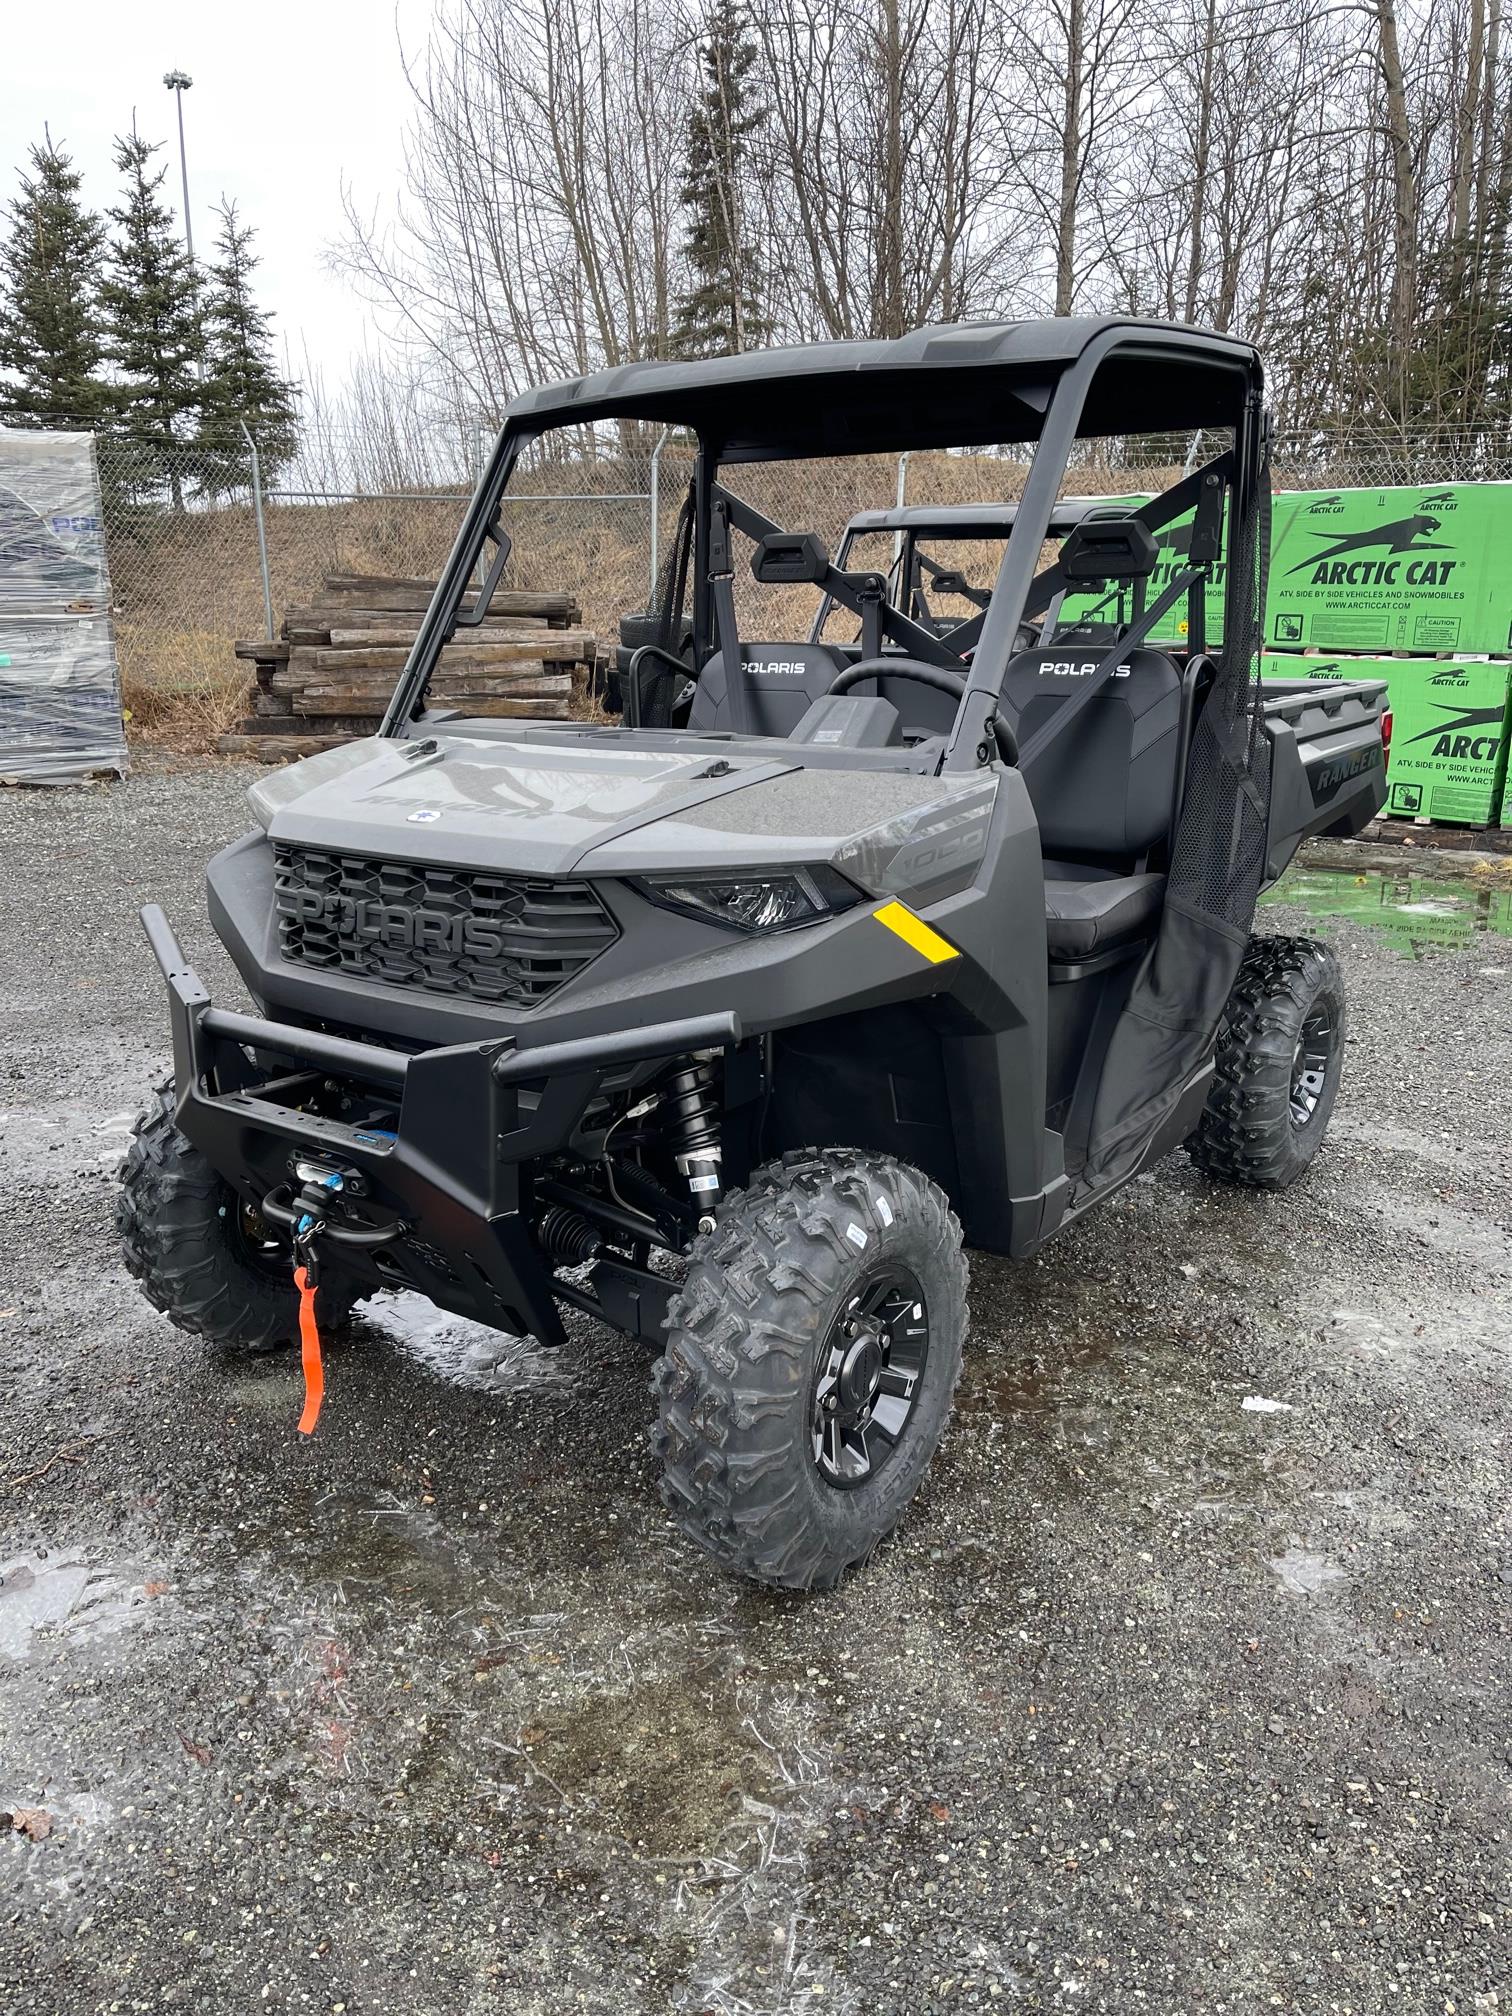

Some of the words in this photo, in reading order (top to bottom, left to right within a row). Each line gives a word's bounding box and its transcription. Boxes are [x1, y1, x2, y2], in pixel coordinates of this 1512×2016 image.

[1309, 506, 1332, 514] ARCTIC
[1420, 503, 1443, 511] ARCTIC
[1445, 503, 1459, 511] CAT
[51, 516, 103, 533] POL
[1311, 561, 1400, 585] ARCTIC
[1405, 561, 1457, 586] CAT
[1296, 590, 1313, 598] SIDE
[1315, 590, 1326, 598] BY
[1327, 590, 1345, 598] SIDE
[1346, 591, 1384, 599] VEHICLES
[1385, 591, 1402, 599] AND
[1404, 591, 1465, 600] SNOWMOBILES
[1325, 601, 1411, 609] WWW.ARCTICCAT.COM
[1039, 662, 1131, 677] POLAS
[1431, 679, 1456, 687] ARCTIC
[1431, 734, 1501, 761] ARCT
[1316, 747, 1379, 791] RANGER
[1415, 761, 1434, 769] SIDE
[1435, 762, 1448, 770] BY
[1448, 764, 1468, 772] SIDE
[1469, 765, 1495, 775] VEHIC
[1447, 774, 1494, 785] WWW.ARCT
[296, 886, 504, 959] POLARIS
